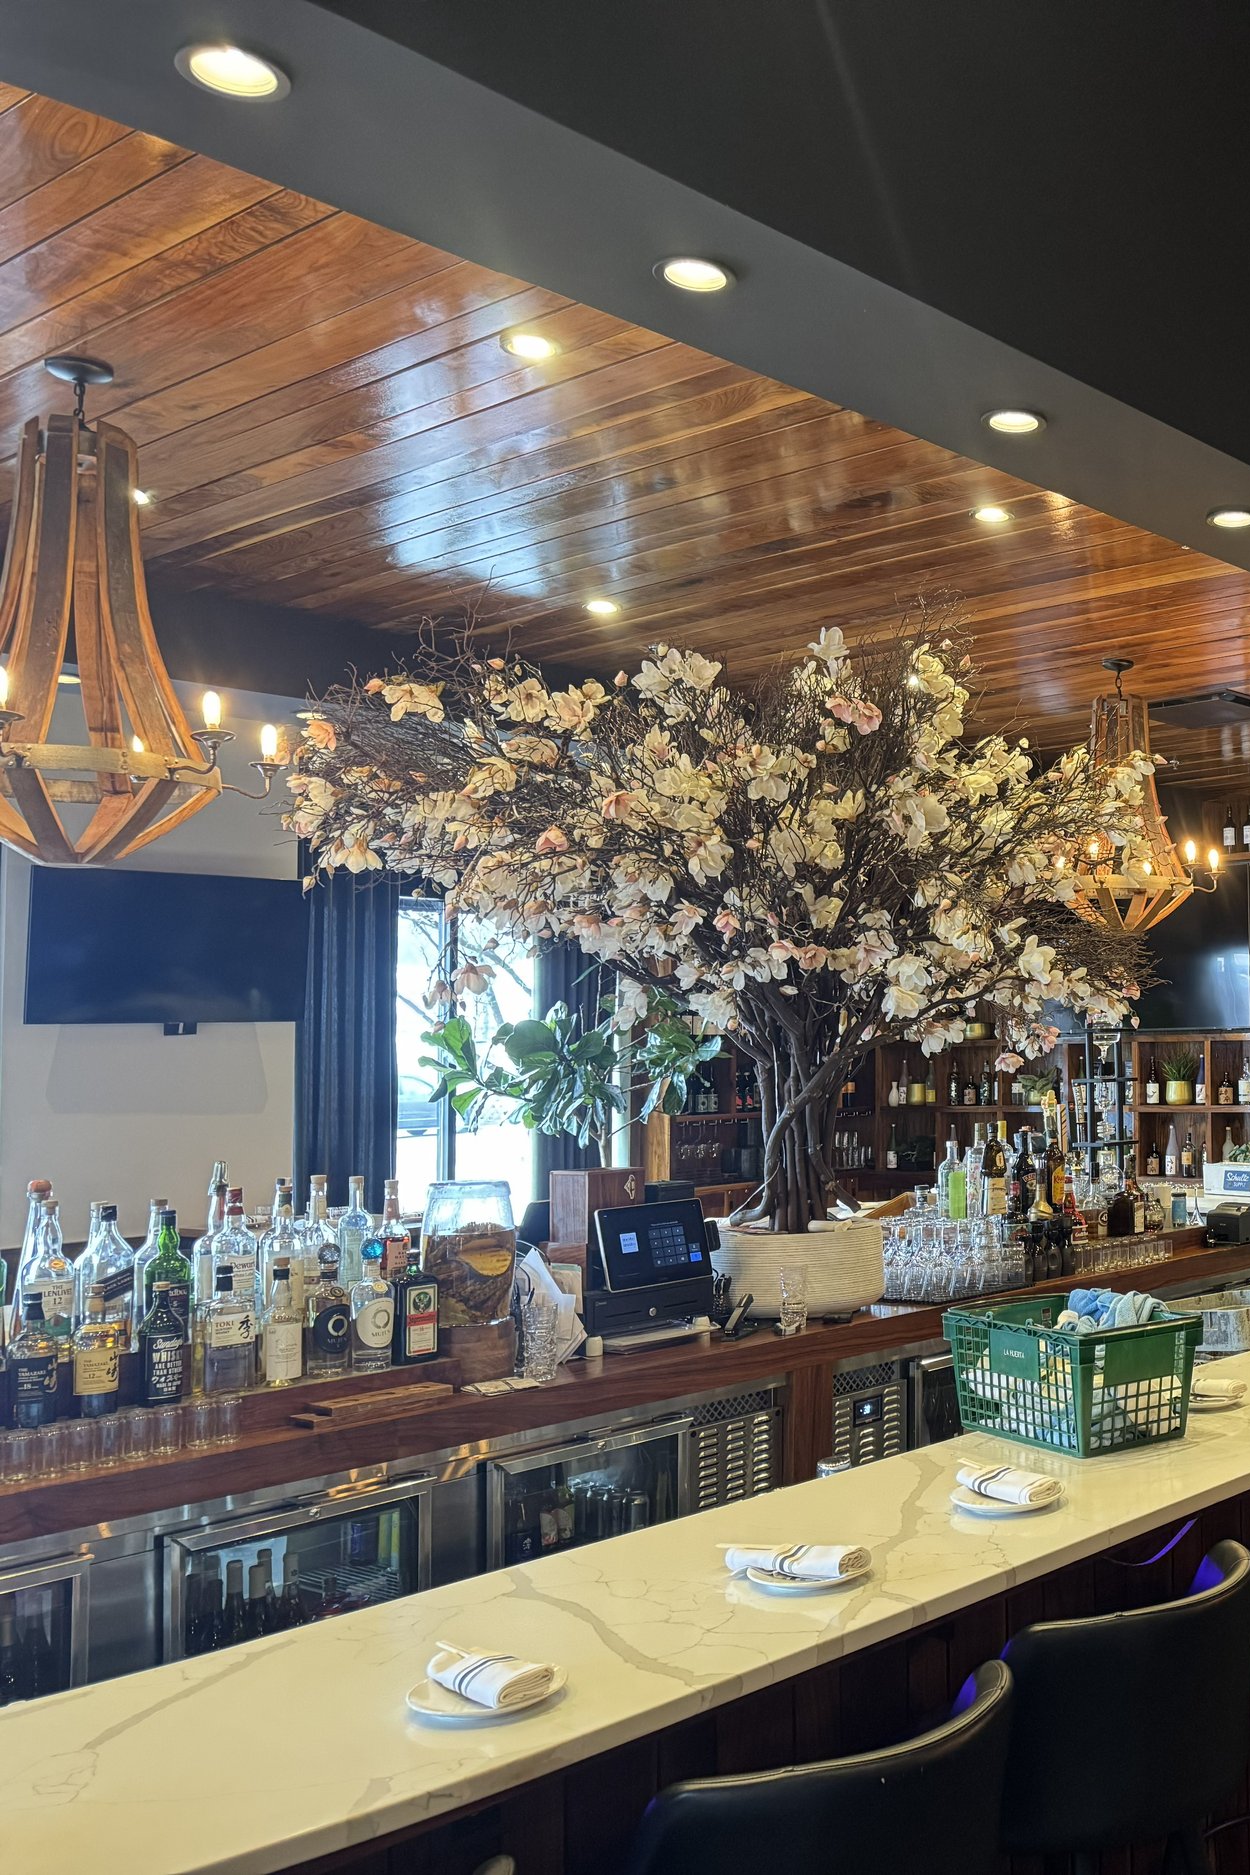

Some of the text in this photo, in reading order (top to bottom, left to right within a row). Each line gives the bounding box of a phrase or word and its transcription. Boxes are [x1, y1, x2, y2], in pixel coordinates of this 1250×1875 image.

[1226, 1172, 1250, 1181] Schultz
[53, 1297, 63, 1305] 12
[215, 1320, 234, 1328] TOKI
[1009, 1350, 1025, 1358] HUERTA
